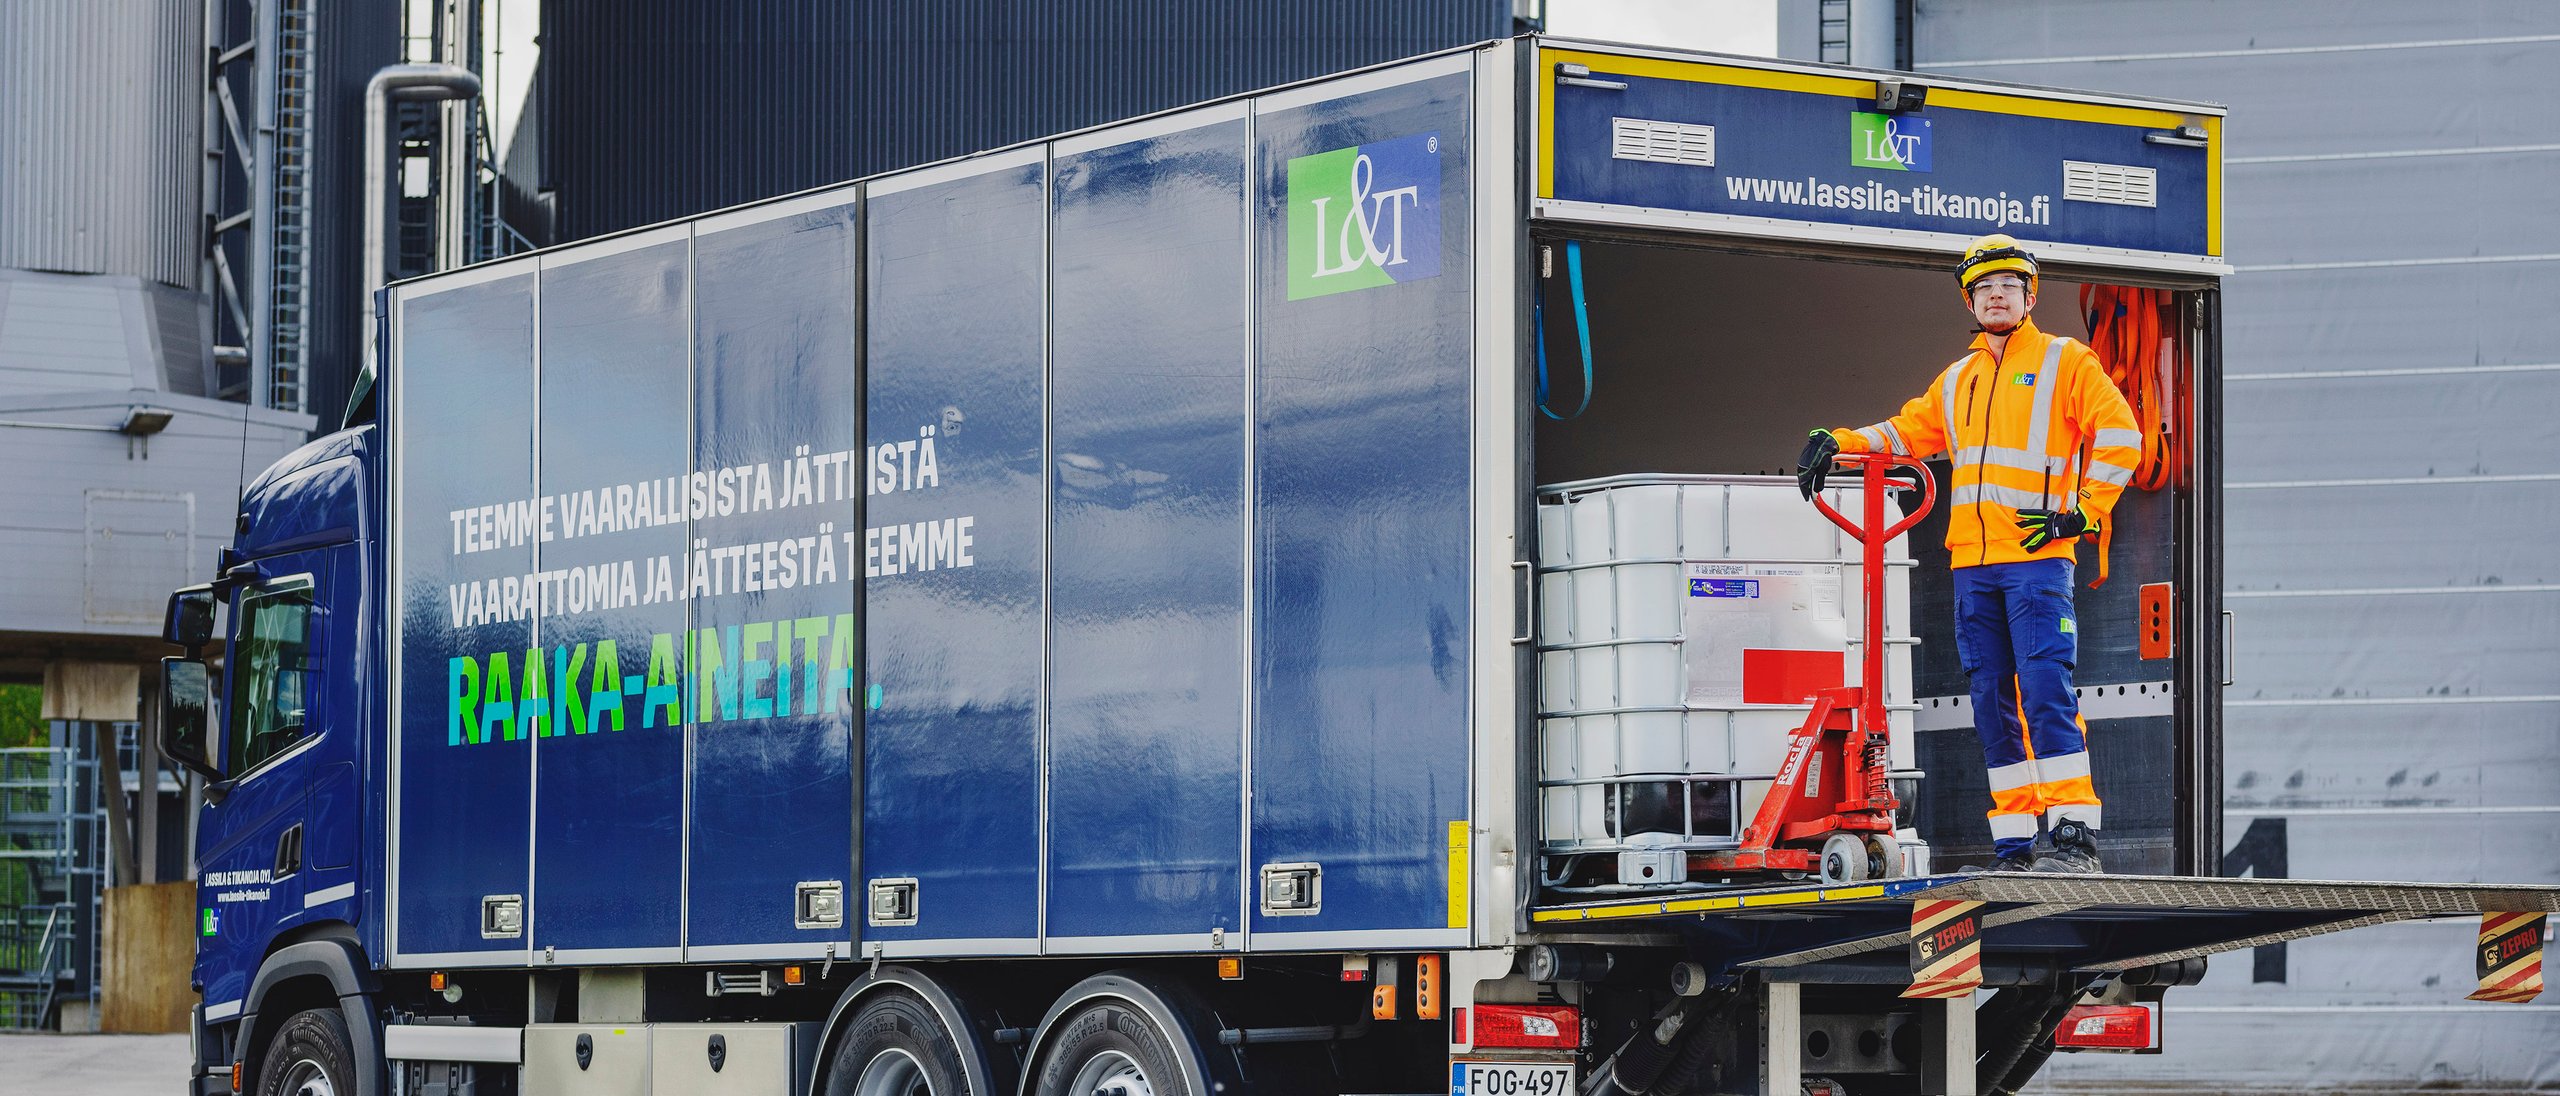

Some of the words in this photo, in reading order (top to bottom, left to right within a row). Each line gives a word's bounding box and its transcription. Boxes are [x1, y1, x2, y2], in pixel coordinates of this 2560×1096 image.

[1864, 118, 1921, 165] L&T
[1312, 154, 1417, 278] L&T
[1725, 176, 2050, 228] www.lassila-tikanoja.fi
[450, 496, 554, 555] TEEMME
[560, 464, 773, 539] VAARALLISISTA
[450, 561, 638, 628] VAARATTOMIA
[643, 555, 674, 605] JA
[680, 522, 837, 600] JÄTTEESTÄ
[448, 613, 883, 747] RAAKA-AINEITA.
[1776, 736, 1806, 785] Rocla
[205, 871, 227, 887] LASSILA
[227, 871, 232, 886] &
[232, 870, 260, 885] TIKANOJA
[260, 869, 270, 884] OYJ
[1935, 917, 1975, 952] ZEPRO
[2501, 927, 2538, 959] ZEPRO
[880, 1022, 895, 1032] 22.5
[1081, 1029, 1088, 1039] R
[1088, 1022, 1104, 1035] 22.5
[1452, 1085, 1465, 1094] FIN
[1471, 1068, 1569, 1096] FOG-497
